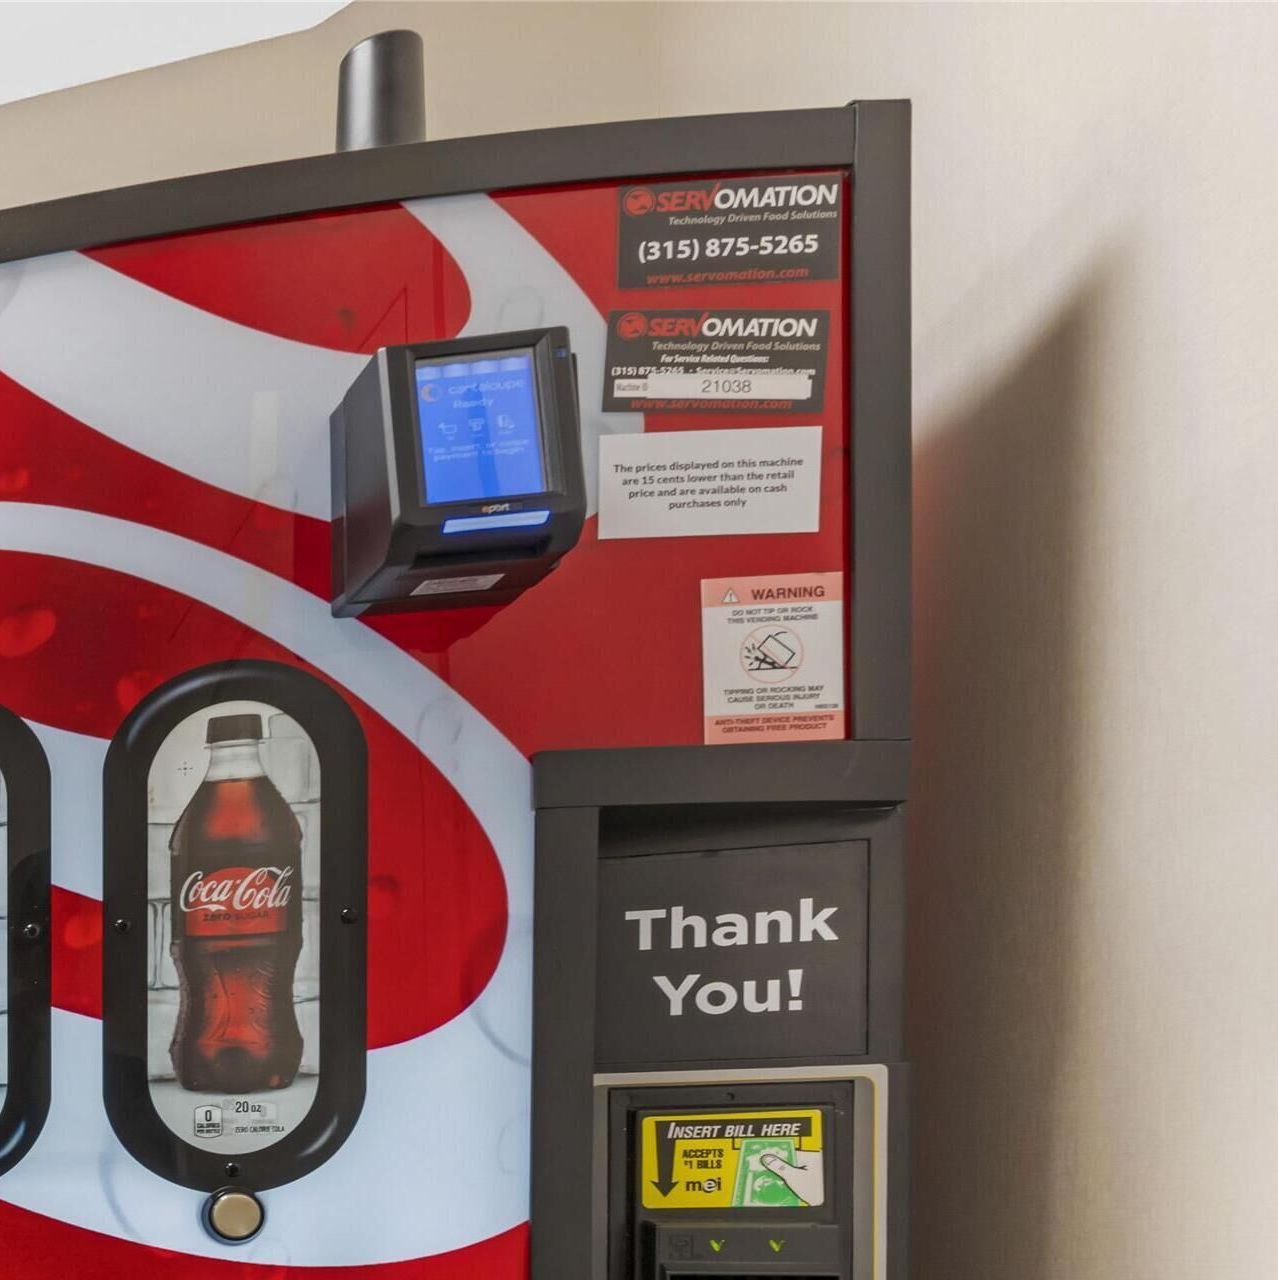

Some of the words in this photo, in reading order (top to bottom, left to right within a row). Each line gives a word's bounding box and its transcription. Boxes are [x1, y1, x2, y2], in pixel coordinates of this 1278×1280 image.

[656, 183, 838, 212] SERVOMATION
[669, 214, 726, 226] Technology
[727, 213, 761, 223] Driven
[763, 212, 788, 221] Food
[790, 210, 837, 220] Solutions
[639, 239, 699, 263] (315)
[705, 234, 819, 258] 875-5265
[647, 267, 809, 284] www.servomation.com
[648, 312, 818, 337] SERVOMATION
[652, 341, 710, 351] Technology
[711, 342, 744, 350] Driven
[746, 341, 772, 350] Food
[774, 341, 820, 350] Solutions
[701, 380, 751, 393] 21038
[613, 464, 633, 473] The
[636, 463, 667, 473] prices
[669, 460, 719, 471] displayed
[737, 459, 757, 468] this
[759, 458, 804, 467] machine
[622, 478, 639, 486] are
[642, 476, 655, 485] 15
[657, 475, 685, 484] cents
[687, 474, 717, 483] lower
[720, 473, 744, 481] than
[747, 472, 763, 480] the
[766, 470, 795, 479] retail
[628, 489, 655, 499] price
[657, 488, 677, 496] and
[699, 485, 746, 495] available
[764, 484, 787, 493] cash
[481, 503, 510, 514] eport
[668, 499, 722, 510] purchases
[724, 498, 747, 508] only
[752, 585, 825, 600] WARNING
[179, 865, 293, 913] Coca-Cola
[625, 898, 839, 950] Thank
[652, 969, 803, 1016] You!
[235, 1101, 249, 1113] 20
[205, 1110, 212, 1121] 0
[667, 1122, 720, 1139] INSERT
[724, 1124, 755, 1137] BILL
[761, 1123, 801, 1136] HERE
[682, 1149, 724, 1158] ACCEPTS
[684, 1160, 693, 1169] $1
[697, 1159, 722, 1169] BILLS
[686, 1177, 721, 1194] mei
